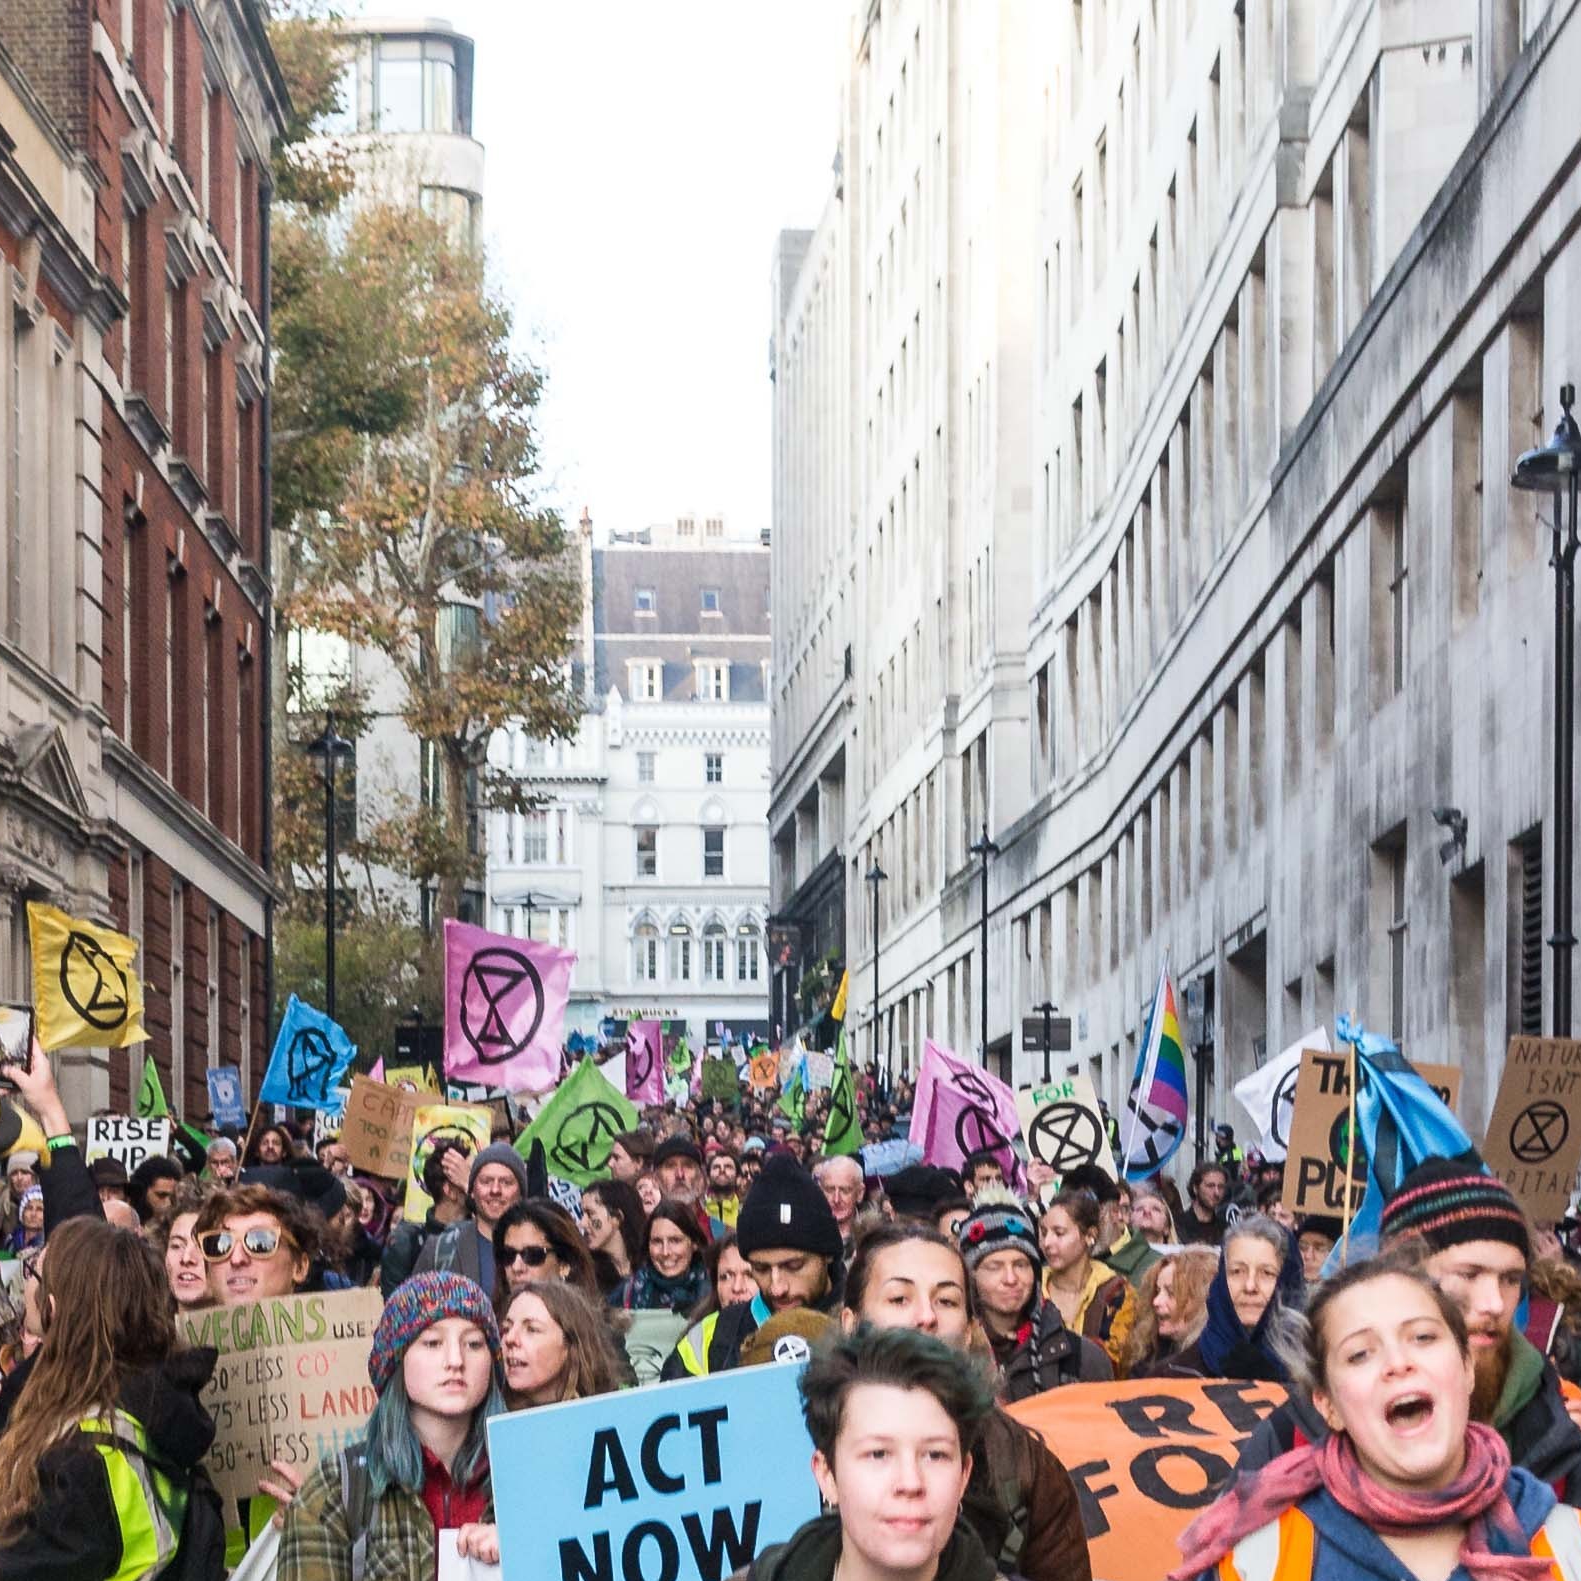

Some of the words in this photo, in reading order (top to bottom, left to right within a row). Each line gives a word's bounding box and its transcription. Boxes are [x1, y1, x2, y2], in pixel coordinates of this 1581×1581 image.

[1032, 1080, 1076, 1106] FOR
[94, 1117, 162, 1142] RISE
[107, 1147, 147, 1170] UP
[1495, 1169, 1573, 1194] PITAL
[185, 1297, 327, 1356] VEGANS
[244, 1355, 284, 1386] LESS
[247, 1391, 289, 1427] LESS
[299, 1384, 377, 1420] LAND
[259, 1431, 310, 1467] LESS
[583, 1404, 729, 1511] ACT
[1067, 1438, 1243, 1540] FO
